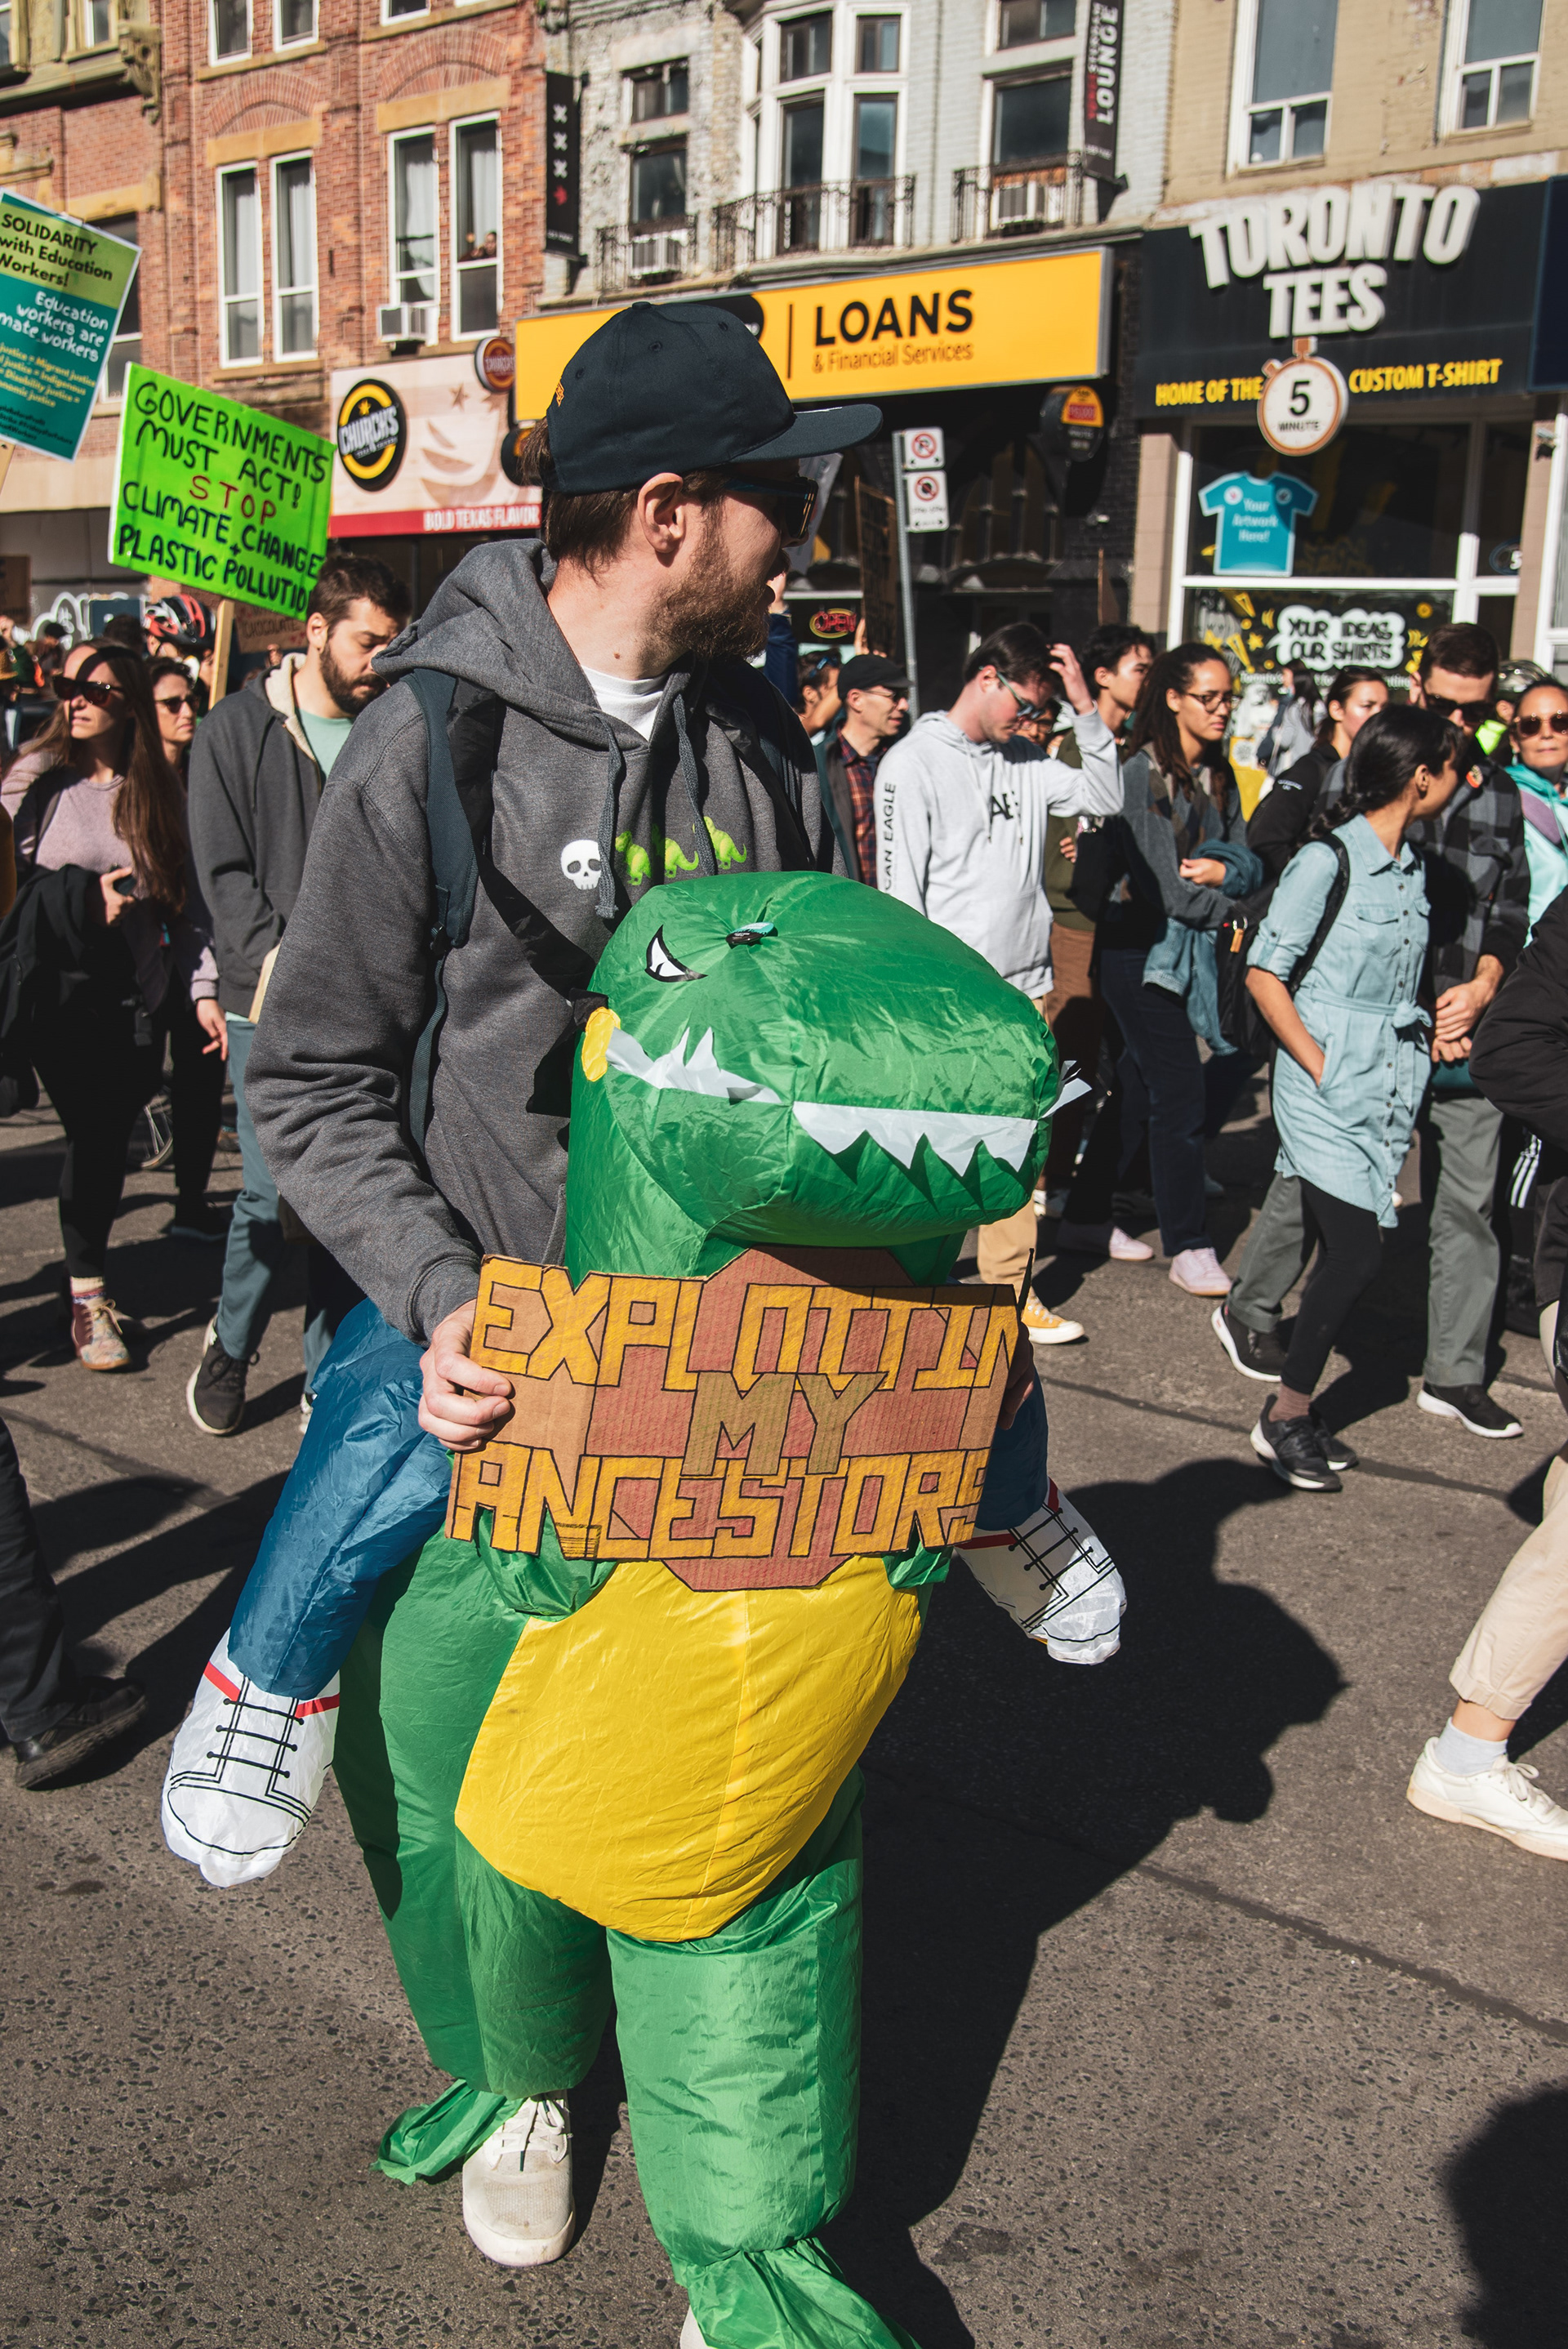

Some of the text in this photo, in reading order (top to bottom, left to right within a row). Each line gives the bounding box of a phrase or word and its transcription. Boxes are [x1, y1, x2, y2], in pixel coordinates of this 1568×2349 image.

[1097, 5, 1118, 125] LOUNGE
[1, 213, 98, 256] SOLIDARITY
[1188, 181, 1481, 289] TORONTO
[38, 246, 113, 281] Education
[35, 291, 109, 330] Education
[815, 289, 973, 346] LOANS
[1263, 263, 1387, 338] TEES
[16, 303, 105, 347] workers are
[42, 332, 99, 363] workers
[812, 341, 973, 373] & Financial Services
[1156, 377, 1263, 406] HOME OF THE
[1348, 358, 1503, 393] CUSTOM T-SHIRT
[1290, 380, 1311, 417] 5
[136, 382, 328, 484] GOVERNMENTS
[1278, 419, 1321, 433] MINUTE
[136, 421, 301, 508] MUST ACT!
[189, 475, 276, 524] STOP
[424, 505, 540, 531] BOLD TEXAS FLAVOR
[1243, 497, 1270, 512] Your
[123, 482, 324, 579] CLIMATE CHANGE
[1232, 513, 1278, 528] Artwork
[1238, 528, 1271, 542] Here!
[119, 524, 309, 612] PLASTIC POLLUTIO
[815, 611, 857, 632] OPEN
[1289, 617, 1392, 640] YOUR IDEAS
[1290, 640, 1392, 662] OUR SHIRTS
[884, 782, 897, 842] EAGLE
[682, 1371, 889, 1477] MY
[445, 1441, 991, 1561] ANCESTORS
